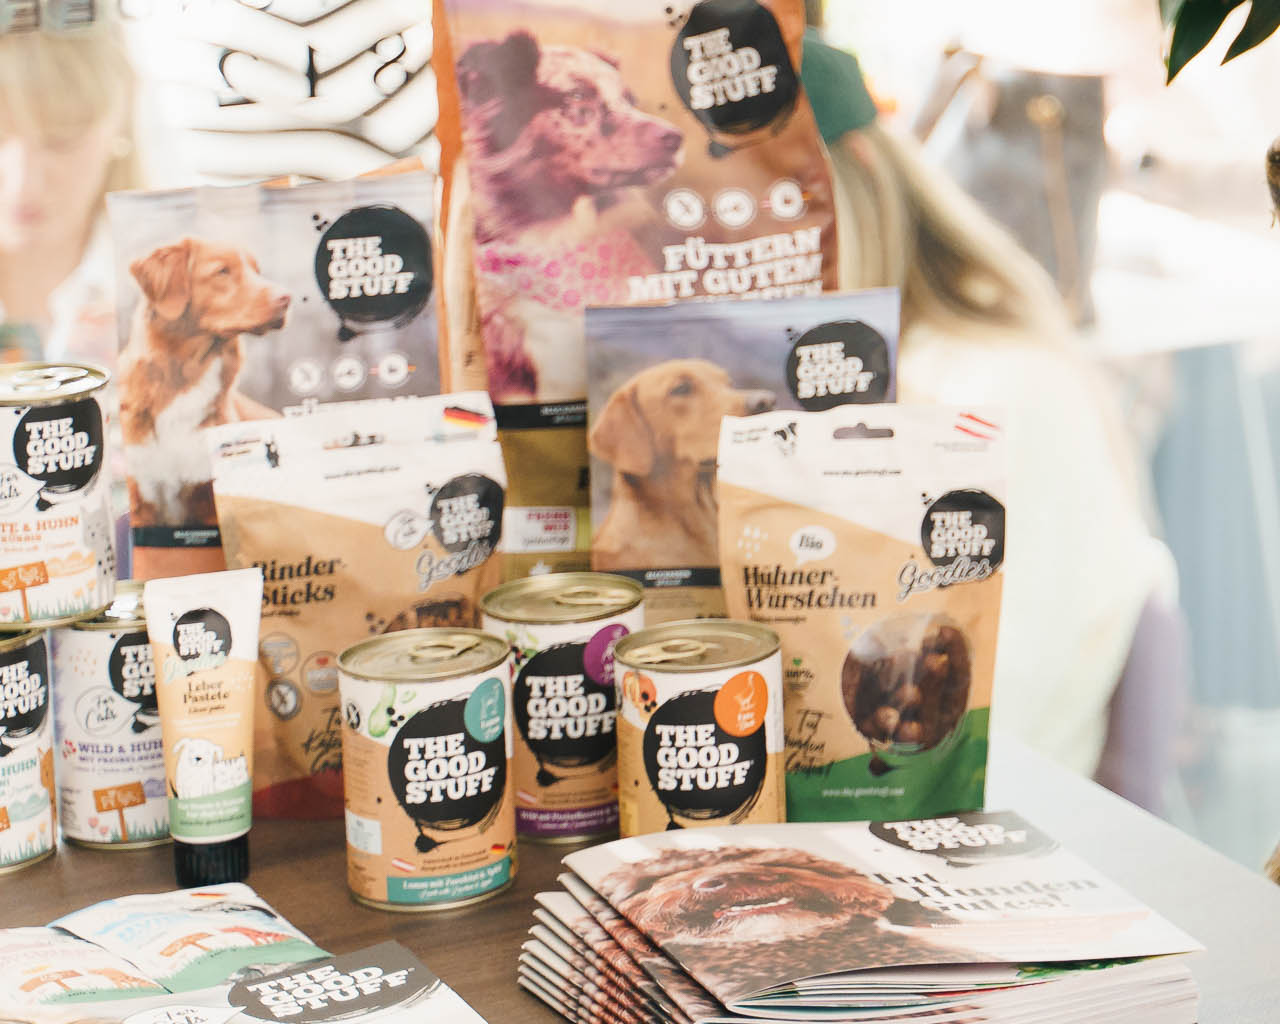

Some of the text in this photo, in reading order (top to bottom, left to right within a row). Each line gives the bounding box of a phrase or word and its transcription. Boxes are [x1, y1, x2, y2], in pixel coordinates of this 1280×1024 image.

[683, 27, 732, 61] THE
[687, 46, 761, 86] GOOD
[690, 65, 778, 110] STUFF
[326, 236, 382, 260] THE
[328, 254, 404, 278] GOOD
[328, 272, 415, 299] STUFF
[628, 270, 699, 301] MIT
[796, 342, 845, 362] THE
[796, 357, 863, 381] GOOD
[797, 371, 874, 399] STUFF
[25, 418, 74, 441] THE
[26, 432, 89, 458] GOOD
[27, 446, 96, 475] STUFF
[437, 494, 479, 516] THE
[440, 507, 490, 532] GOOD
[442, 520, 494, 544] STUFF
[930, 511, 972, 529] THE
[930, 524, 988, 544] GOOD
[930, 538, 996, 559] STUFF
[896, 556, 993, 602] Goodies
[120, 644, 152, 662] TH
[122, 663, 155, 685] GO
[525, 675, 584, 699] THE
[526, 693, 607, 718] GOOD
[528, 710, 617, 740] STUFF
[656, 723, 715, 747] THE
[78, 743, 113, 754] WILD
[131, 739, 164, 753] HUH
[403, 733, 465, 760] THE
[656, 742, 739, 769] GOOD
[405, 750, 486, 782] GOOD
[658, 760, 750, 791] STUFF
[405, 766, 497, 804] STUFF
[246, 965, 337, 996] THE
[259, 967, 384, 1006] GOOD
[269, 968, 412, 1018] STUFF
